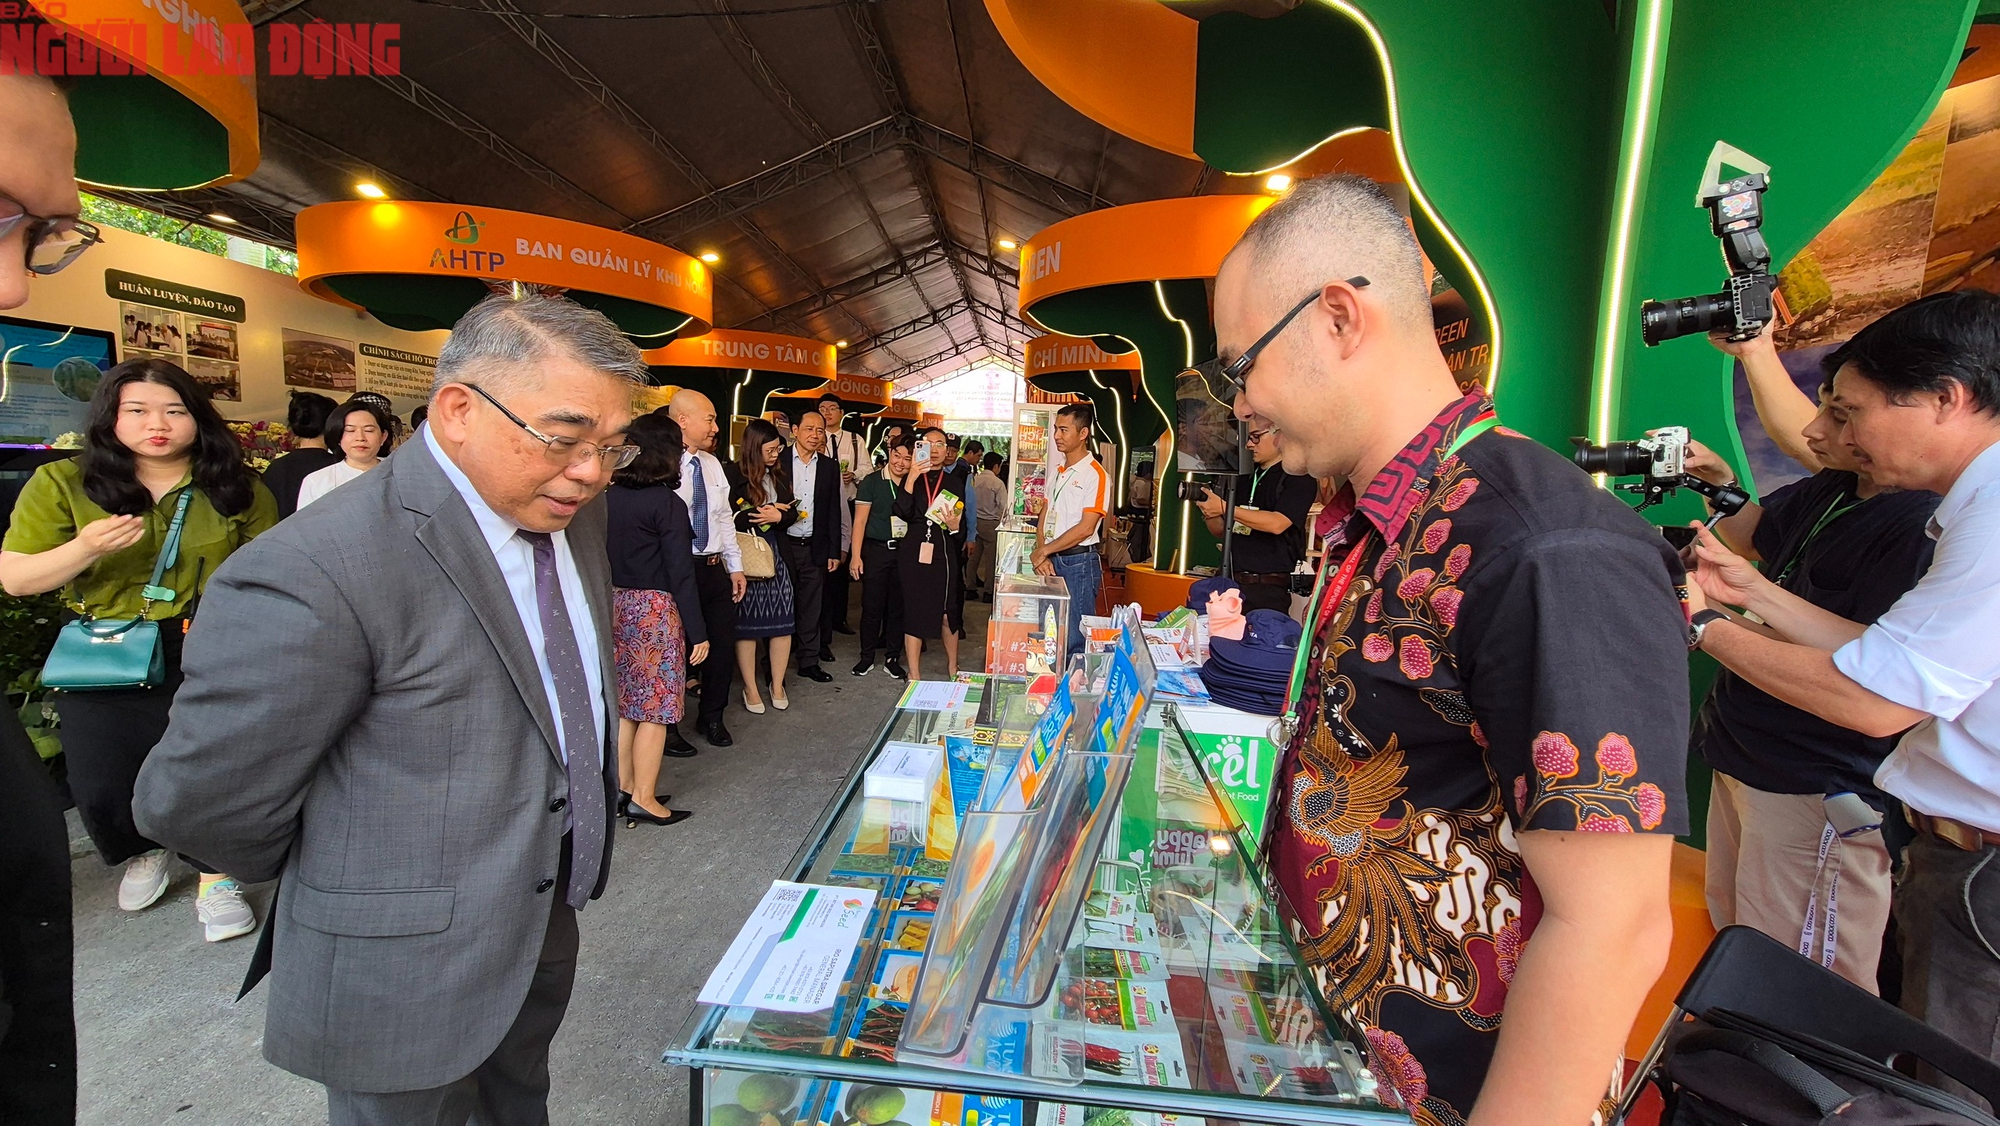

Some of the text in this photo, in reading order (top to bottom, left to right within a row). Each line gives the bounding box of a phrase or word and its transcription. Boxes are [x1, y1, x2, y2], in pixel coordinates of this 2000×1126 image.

[429, 248, 505, 272] AHTP
[516, 238, 563, 261] BAN
[570, 248, 628, 273] QUẢN
[634, 259, 652, 279] LÝ
[655, 266, 682, 287] KHU
[153, 289, 192, 305] LUYỆN,
[193, 296, 215, 308] ĐÀO
[215, 301, 236, 314] TẠO
[702, 339, 771, 360] TRUNG
[775, 342, 809, 364] TÂM
[1034, 342, 1058, 369] CHÍ
[1237, 792, 1260, 802] Food
